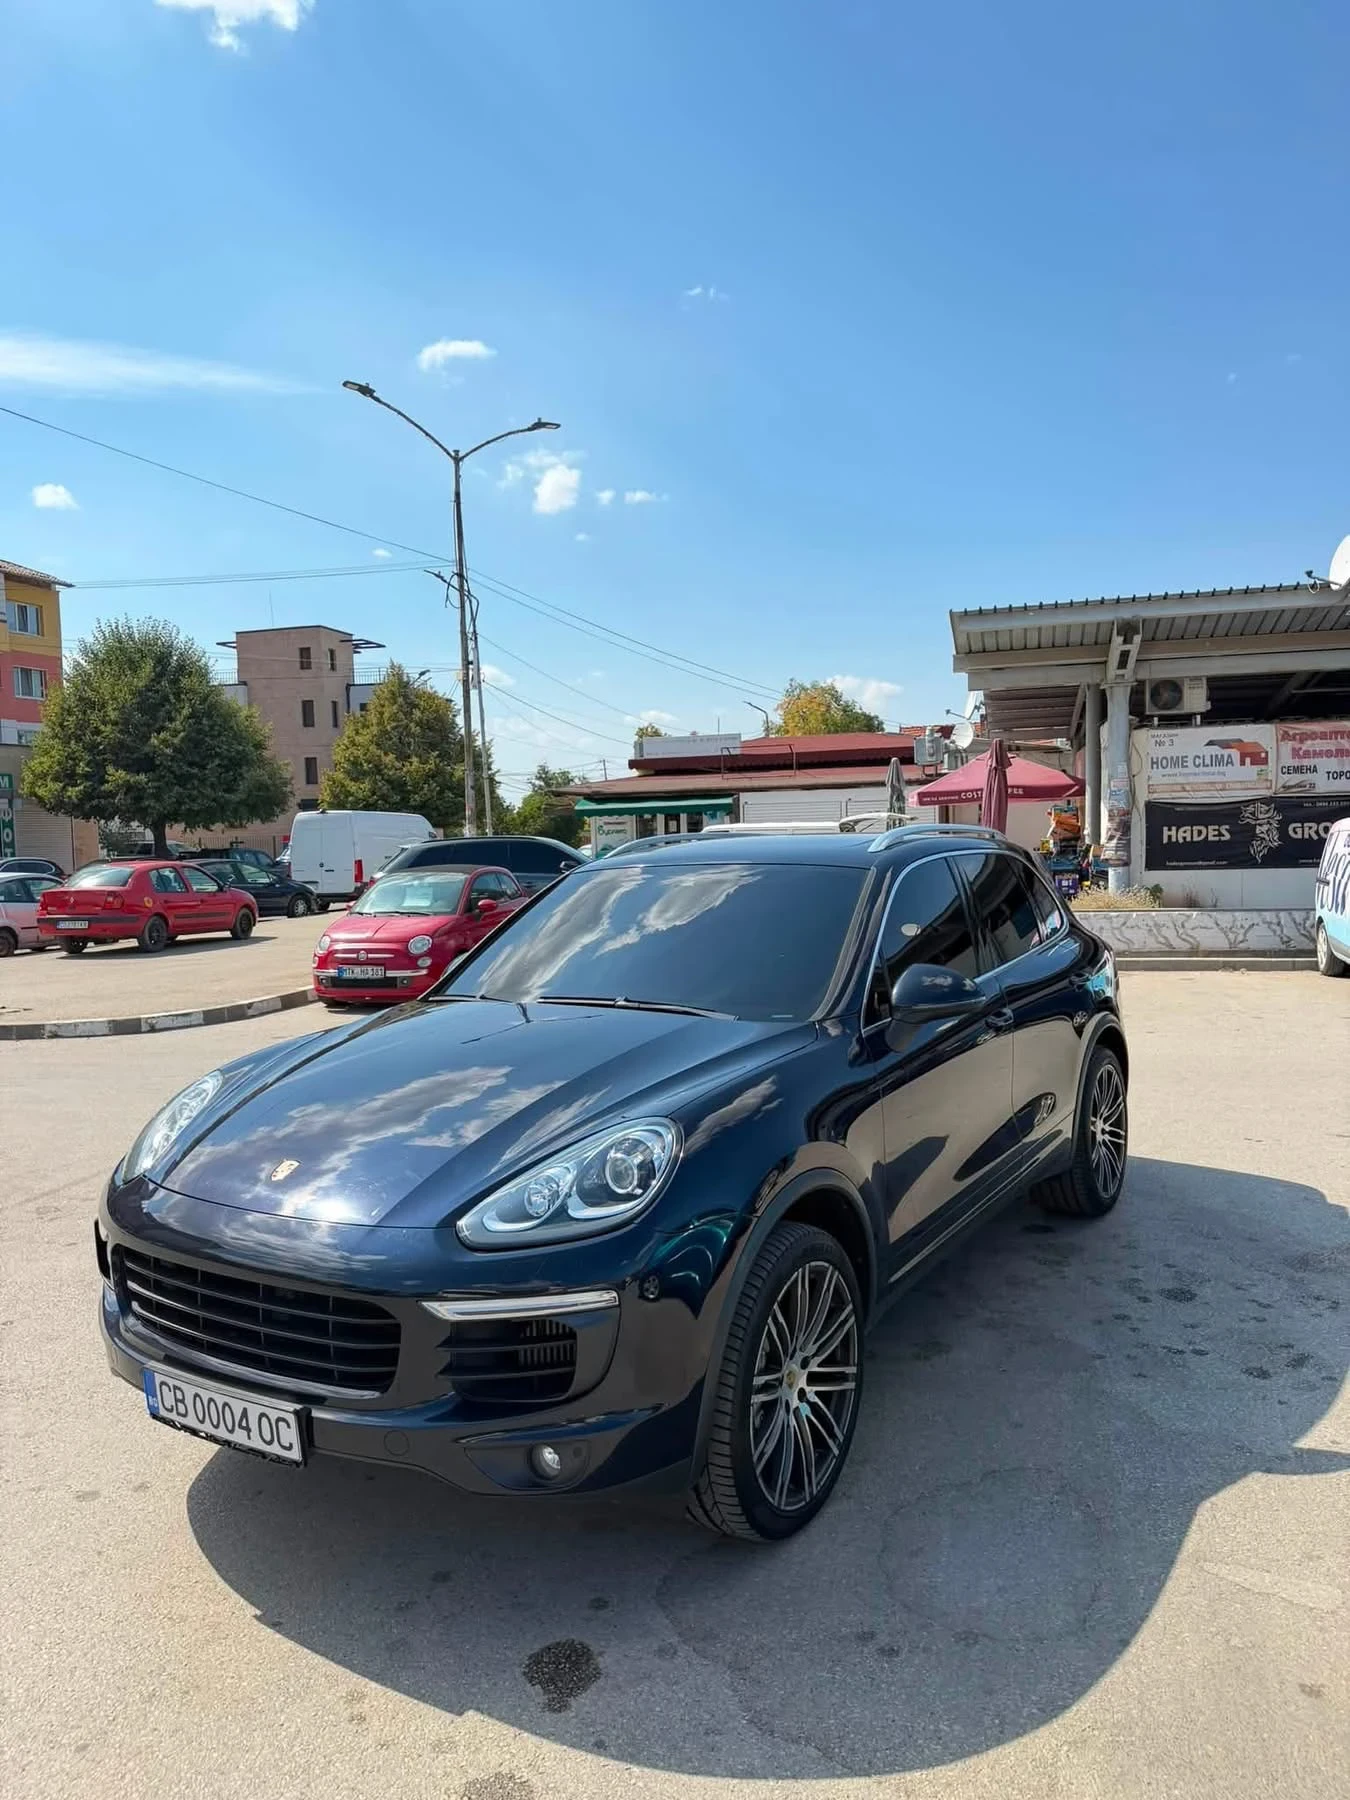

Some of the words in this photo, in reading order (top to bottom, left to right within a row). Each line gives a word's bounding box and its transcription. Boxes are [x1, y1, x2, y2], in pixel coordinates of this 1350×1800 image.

[1151, 755, 1189, 770] HOME
[1193, 753, 1235, 768] CLIMA
[1281, 765, 1318, 775] СЕМЕНА
[961, 791, 984, 799] COST
[1163, 825, 1231, 844] HADES
[159, 1381, 188, 1418] CB
[193, 1392, 252, 1440] 0004
[258, 1412, 293, 1451] OC
